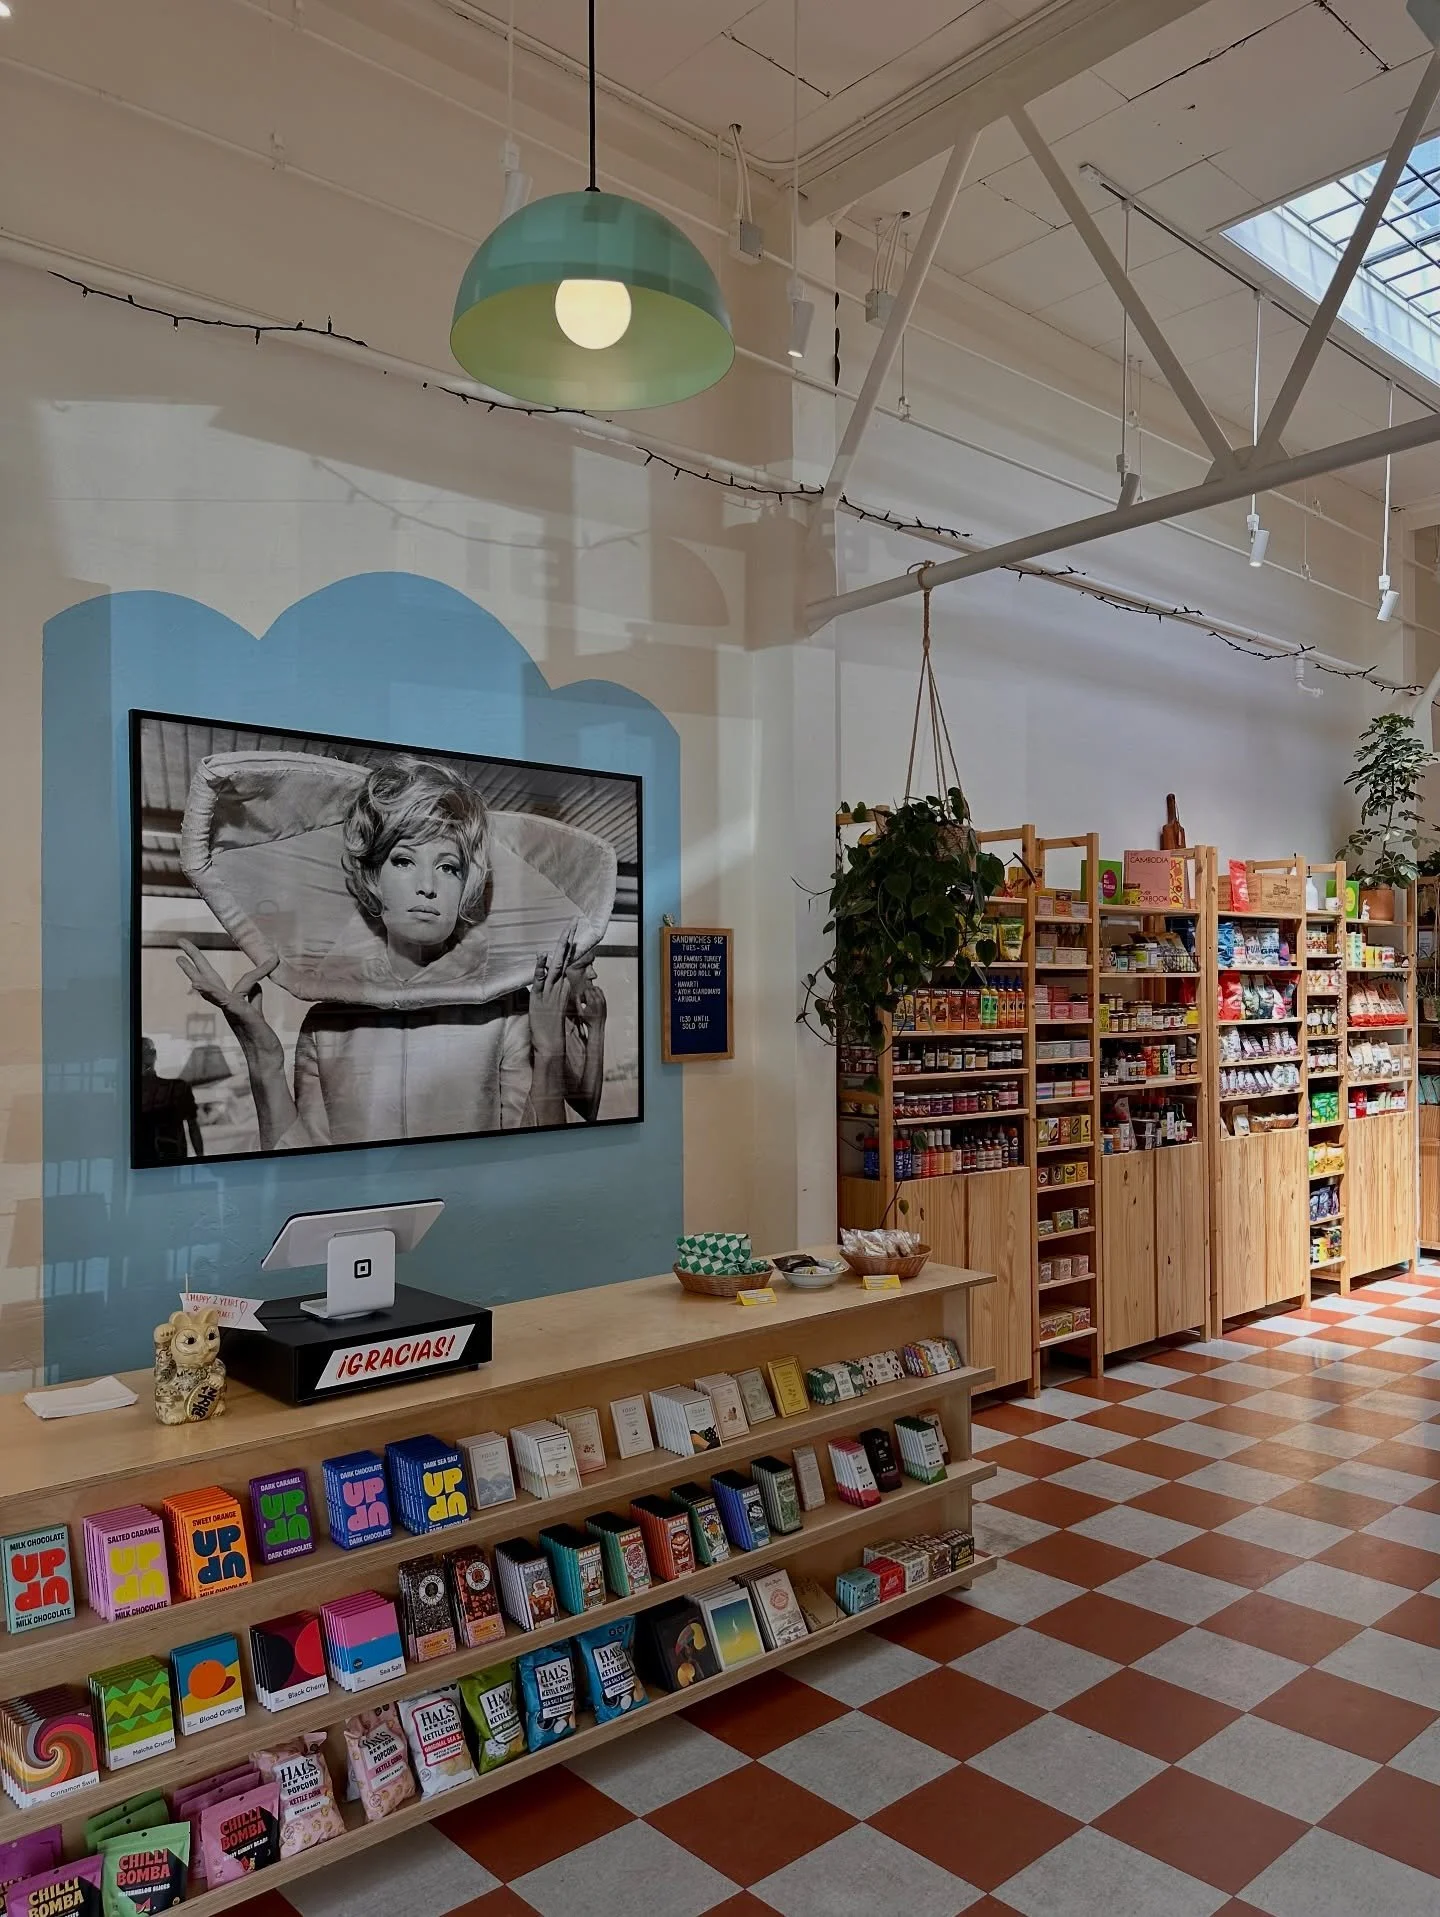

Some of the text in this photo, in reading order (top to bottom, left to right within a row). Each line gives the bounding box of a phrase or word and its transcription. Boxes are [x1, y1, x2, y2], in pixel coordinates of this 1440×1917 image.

[1130, 856, 1169, 864] CAMBODIA
[671, 935, 724, 944] SANDWICHES $12
[672, 962, 698, 970] SANDWICH
[681, 1022, 696, 1030] SOLD
[693, 1014, 710, 1022] UNTIL
[337, 1334, 456, 1379] ¡GRACIAS!
[339, 1463, 383, 1479] DARK CHOCOLATE
[423, 1460, 437, 1470] DARK
[437, 1457, 448, 1467] SEA
[260, 1476, 301, 1492] DARK CARAMEL
[192, 1510, 238, 1528] SWEET ORANGE
[9, 1532, 65, 1552] MILK CHOCOLATE
[107, 1526, 161, 1545] SALTED CARAMEL
[349, 1528, 392, 1546] DARK CHOCOLATE
[267, 1542, 313, 1561] DARK CHOCOLATE
[16, 1607, 71, 1629] MILK CHOCOLATE
[115, 1600, 168, 1621] MILK CHOCOLATE
[379, 1663, 402, 1676] Sea Salt
[601, 1664, 620, 1678] KETTLE
[603, 1660, 615, 1669] NEW
[540, 1664, 569, 1684] HAL'S
[555, 1676, 570, 1684] YORK
[287, 1682, 326, 1700] Black Cherry
[542, 1687, 559, 1697] KETTLE
[199, 1710, 219, 1725] Blood
[219, 1704, 243, 1719] Orange
[420, 1704, 455, 1727] HAL'S
[489, 1710, 509, 1725] KETTLE
[424, 1717, 457, 1732] NEW YORK
[422, 1728, 445, 1742] KETTLE
[132, 1737, 175, 1757] Matcha Crunch
[369, 1737, 395, 1755] NEW YORK
[373, 1743, 398, 1763] POPCORN
[424, 1740, 448, 1753] ORIGINAL
[280, 1758, 317, 1783] HAL'S
[375, 1760, 391, 1774] KETTLE
[50, 1777, 97, 1799] Cinnamon Swirl
[282, 1770, 319, 1788] NEW YORK
[287, 1777, 319, 1795] POPCORN
[289, 1793, 308, 1806] KETTLE
[220, 1806, 261, 1835] CHILLI
[221, 1819, 267, 1850] BOMBA
[119, 1848, 168, 1870] CHILLI
[117, 1864, 170, 1886] BOMBA
[28, 1876, 80, 1906] CHILLI
[28, 1889, 84, 1917] BOMBA
